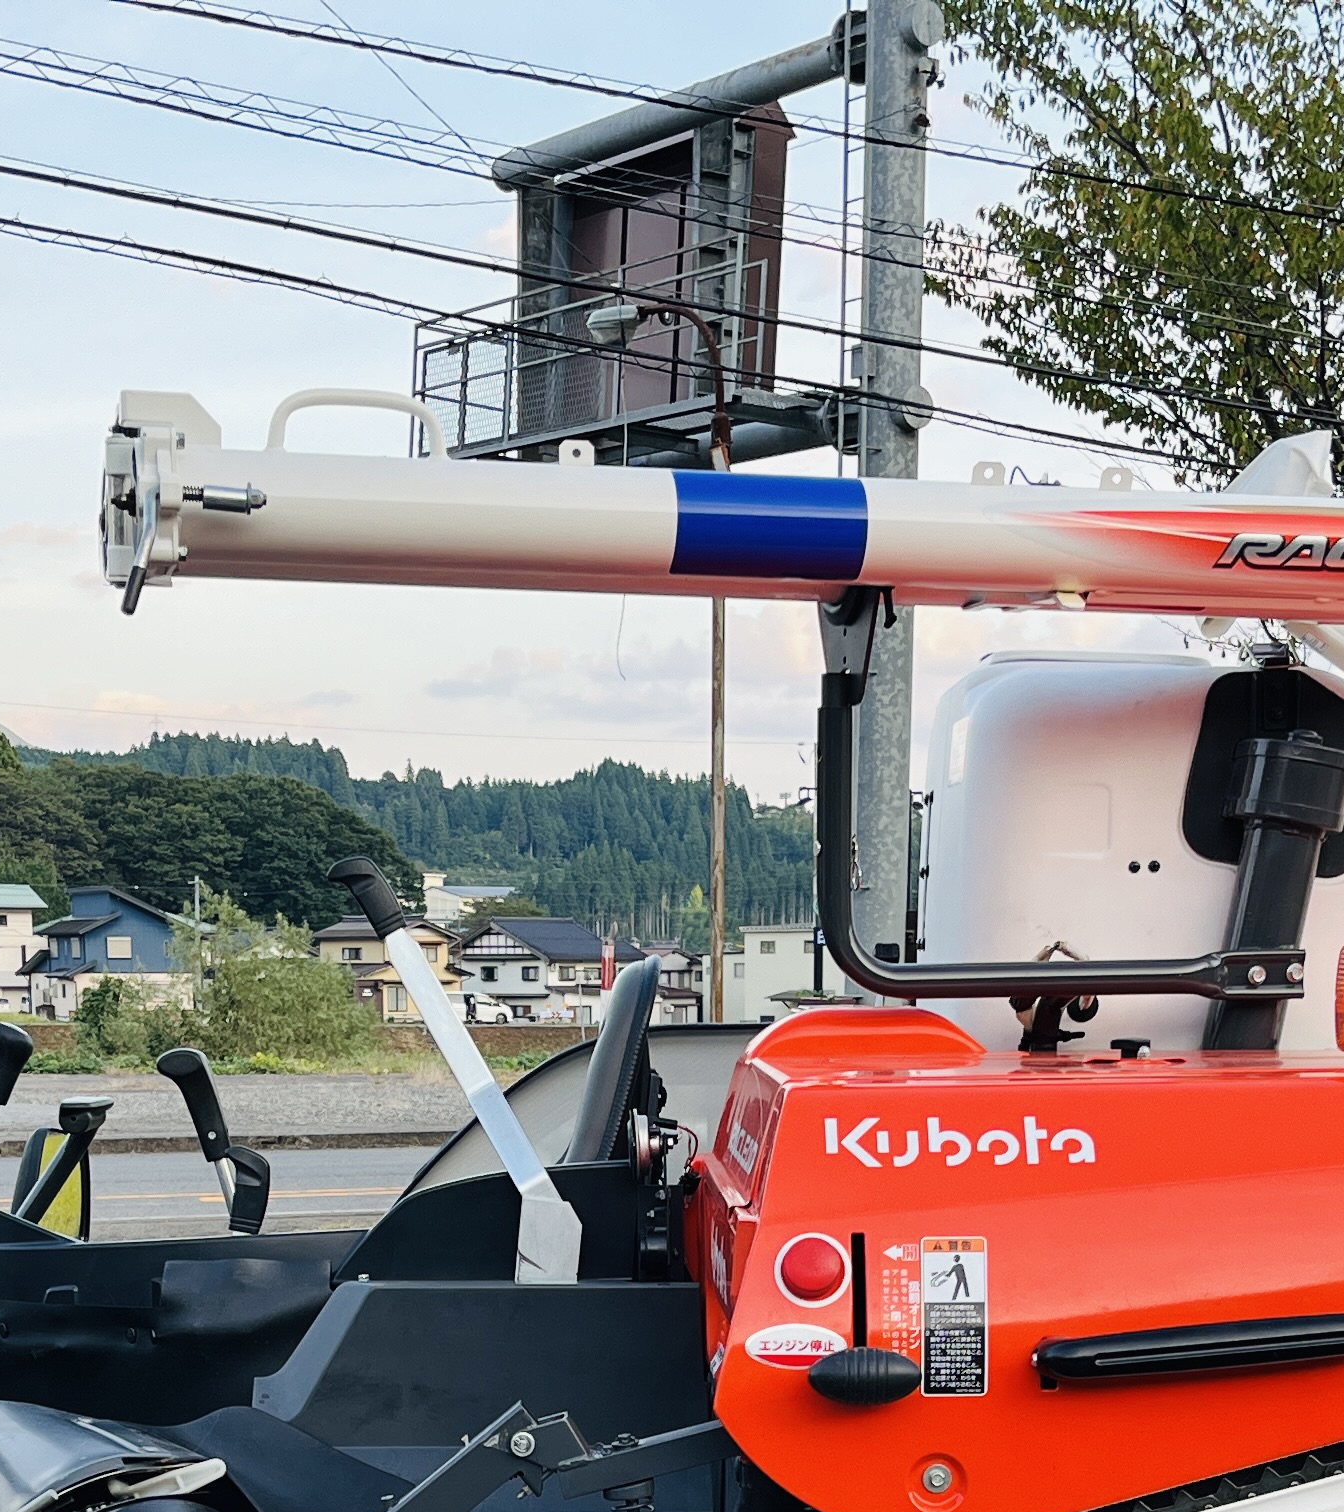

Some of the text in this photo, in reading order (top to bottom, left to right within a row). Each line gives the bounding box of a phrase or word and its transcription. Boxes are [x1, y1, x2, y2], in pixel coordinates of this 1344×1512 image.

[824, 1115, 1096, 1168] Kubota
[758, 1339, 835, 1353] エンジン停止
